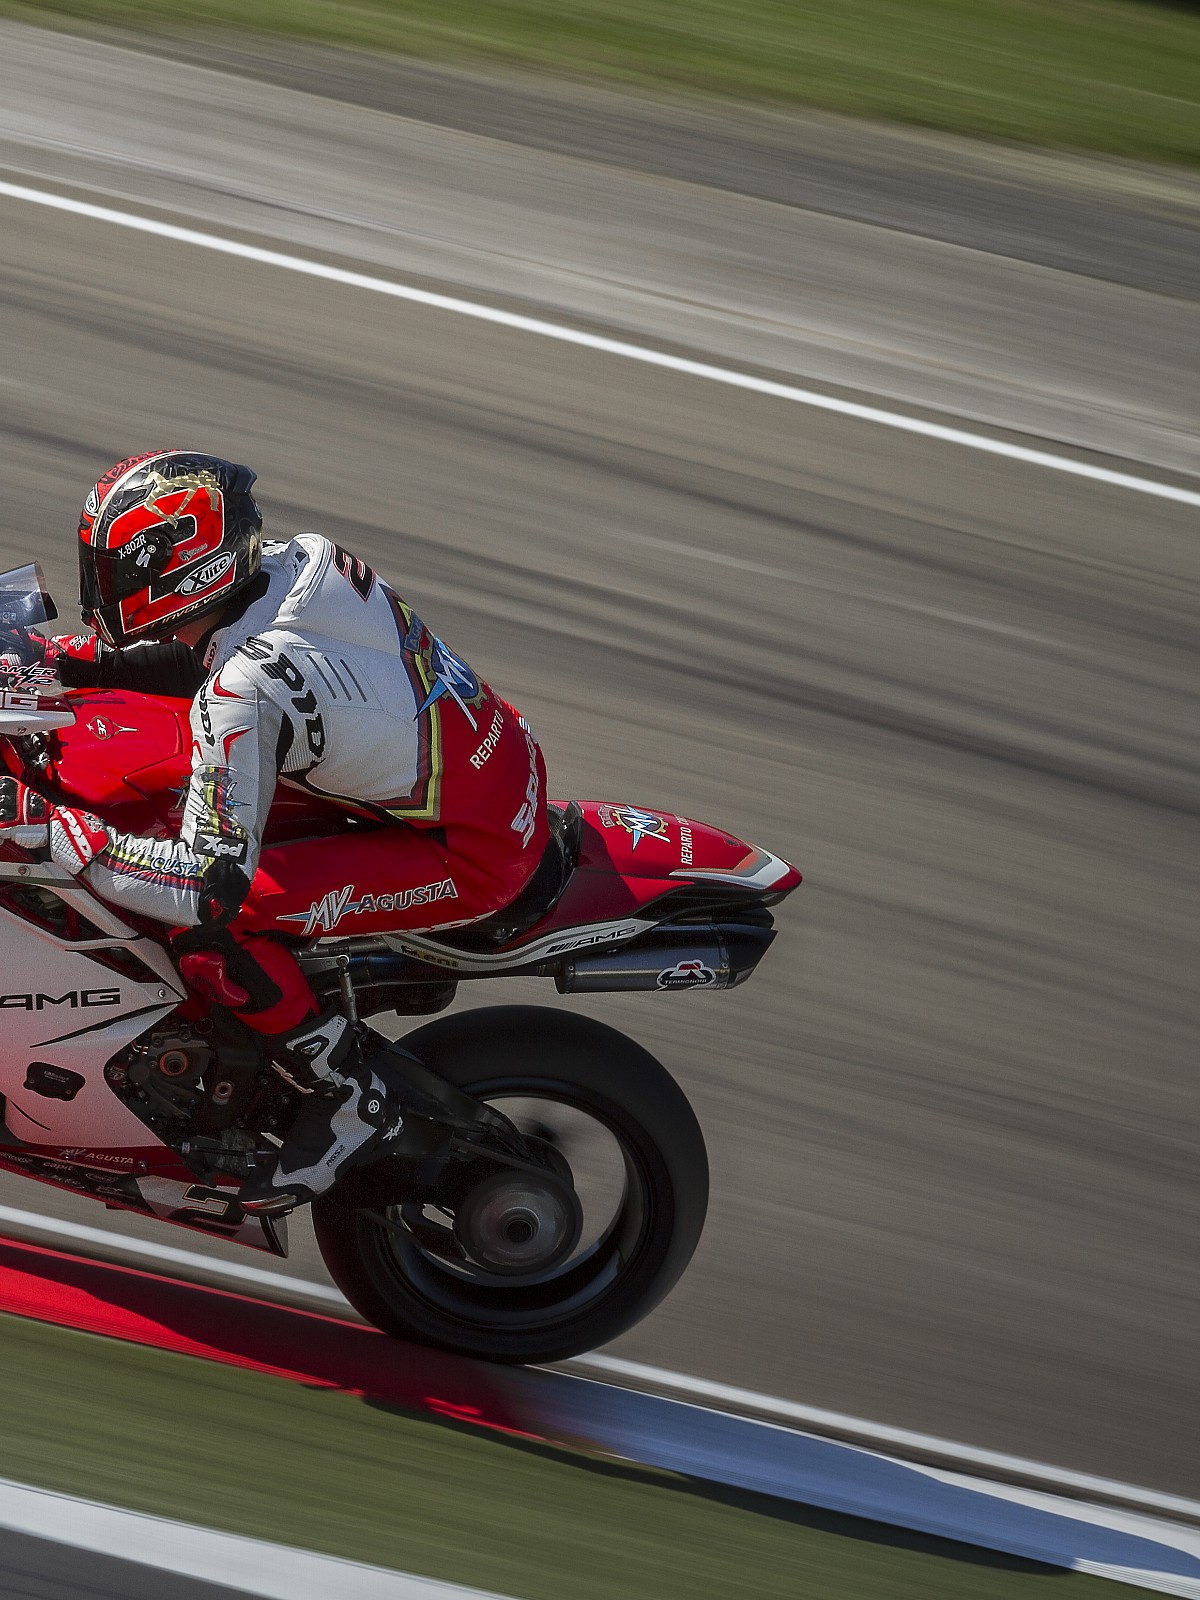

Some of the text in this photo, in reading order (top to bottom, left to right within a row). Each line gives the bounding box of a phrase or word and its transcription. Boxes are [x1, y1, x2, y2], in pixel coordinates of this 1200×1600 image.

[469, 709, 504, 770] REPARTO
[203, 834, 242, 858] Xpd
[680, 826, 693, 866] REPARTO
[354, 878, 459, 915] AGUSTA
[572, 925, 637, 947] AMG
[85, 1152, 134, 1165] AGUSTA
